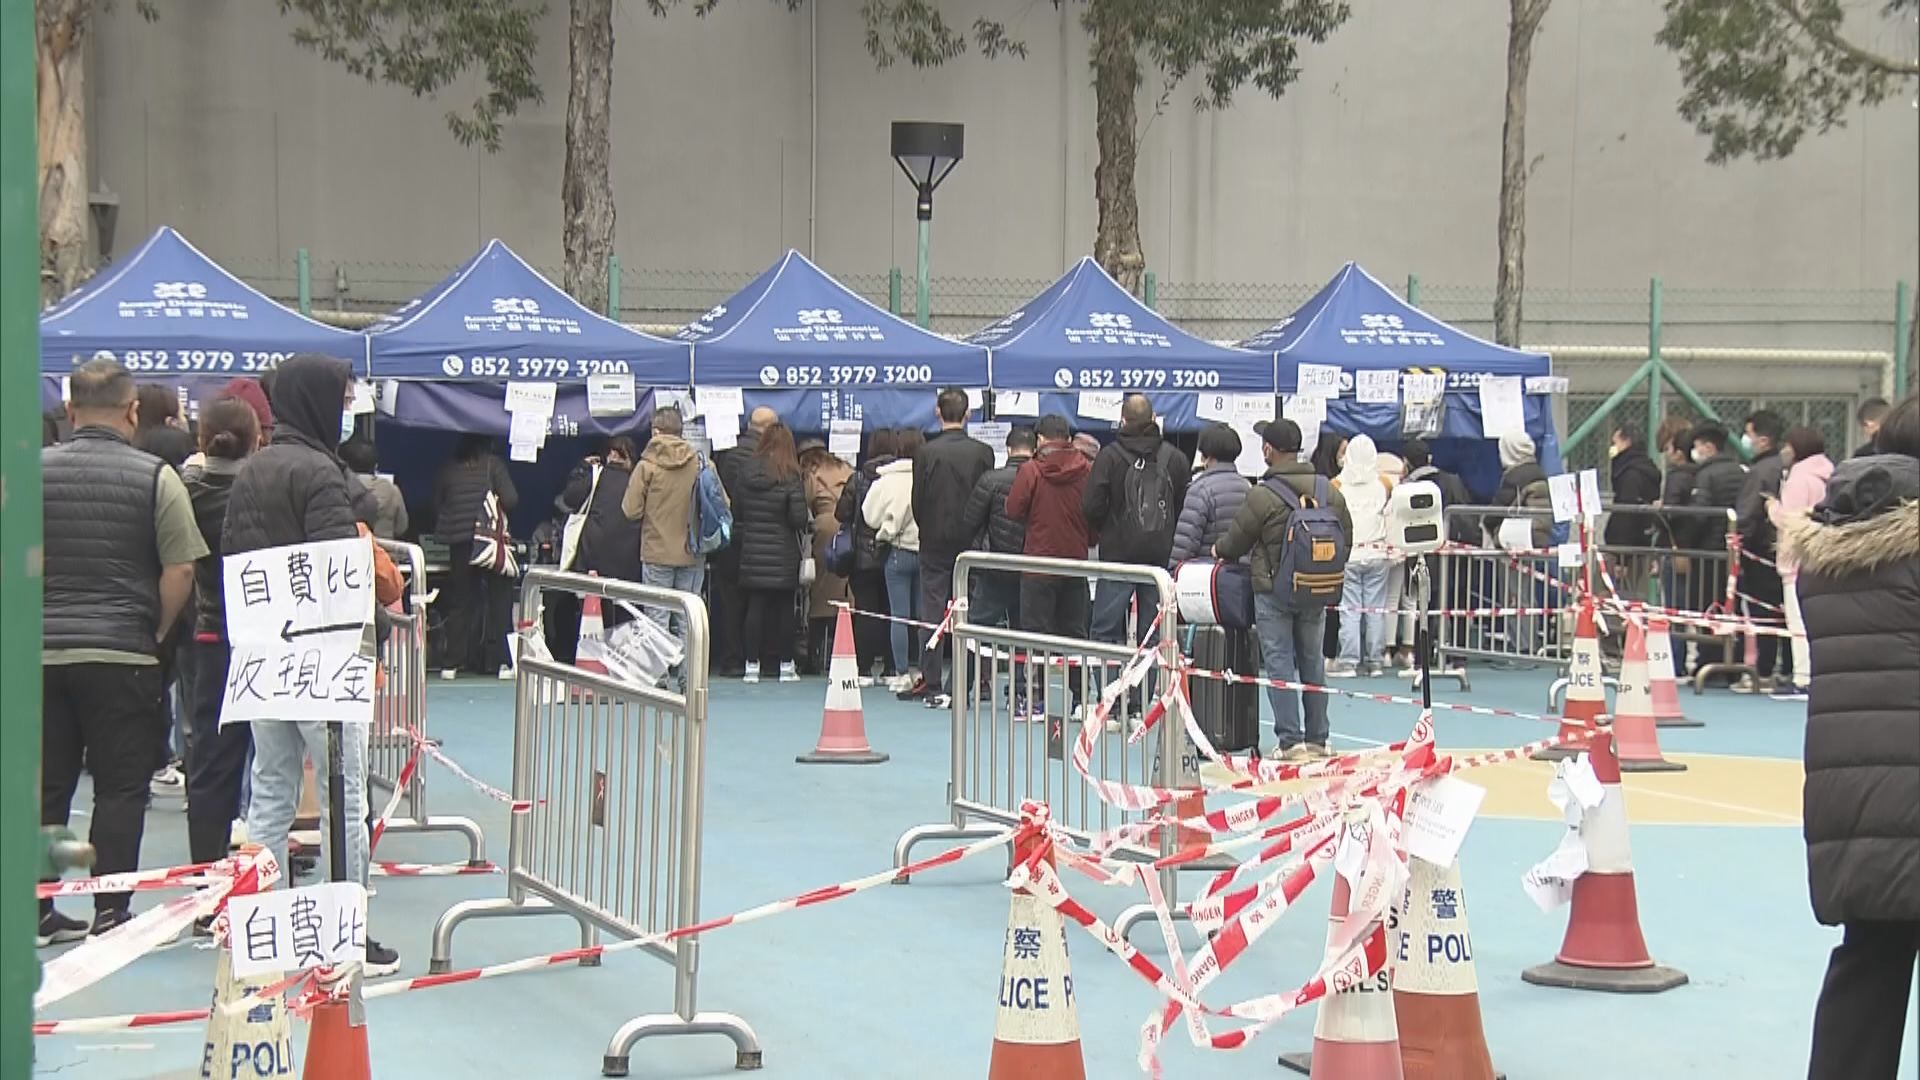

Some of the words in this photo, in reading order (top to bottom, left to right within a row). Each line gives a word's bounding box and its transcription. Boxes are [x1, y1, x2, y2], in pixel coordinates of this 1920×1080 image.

[124, 350, 169, 371] 852
[177, 351, 234, 371] 3979
[471, 356, 510, 376] 852
[517, 357, 569, 377] 3979
[576, 360, 629, 377] 3200
[786, 366, 822, 385] 852
[829, 366, 876, 384] 3979
[883, 365, 932, 384] 3200
[1079, 369, 1114, 388] 852
[1120, 369, 1166, 387] 3979
[1172, 369, 1219, 387] 3200
[1215, 396, 1223, 411] 8
[241, 552, 372, 607] 自費比
[230, 650, 374, 704] 收現金
[1431, 888, 1457, 919] 警
[245, 896, 366, 967] 自費比
[1014, 926, 1041, 959] 察
